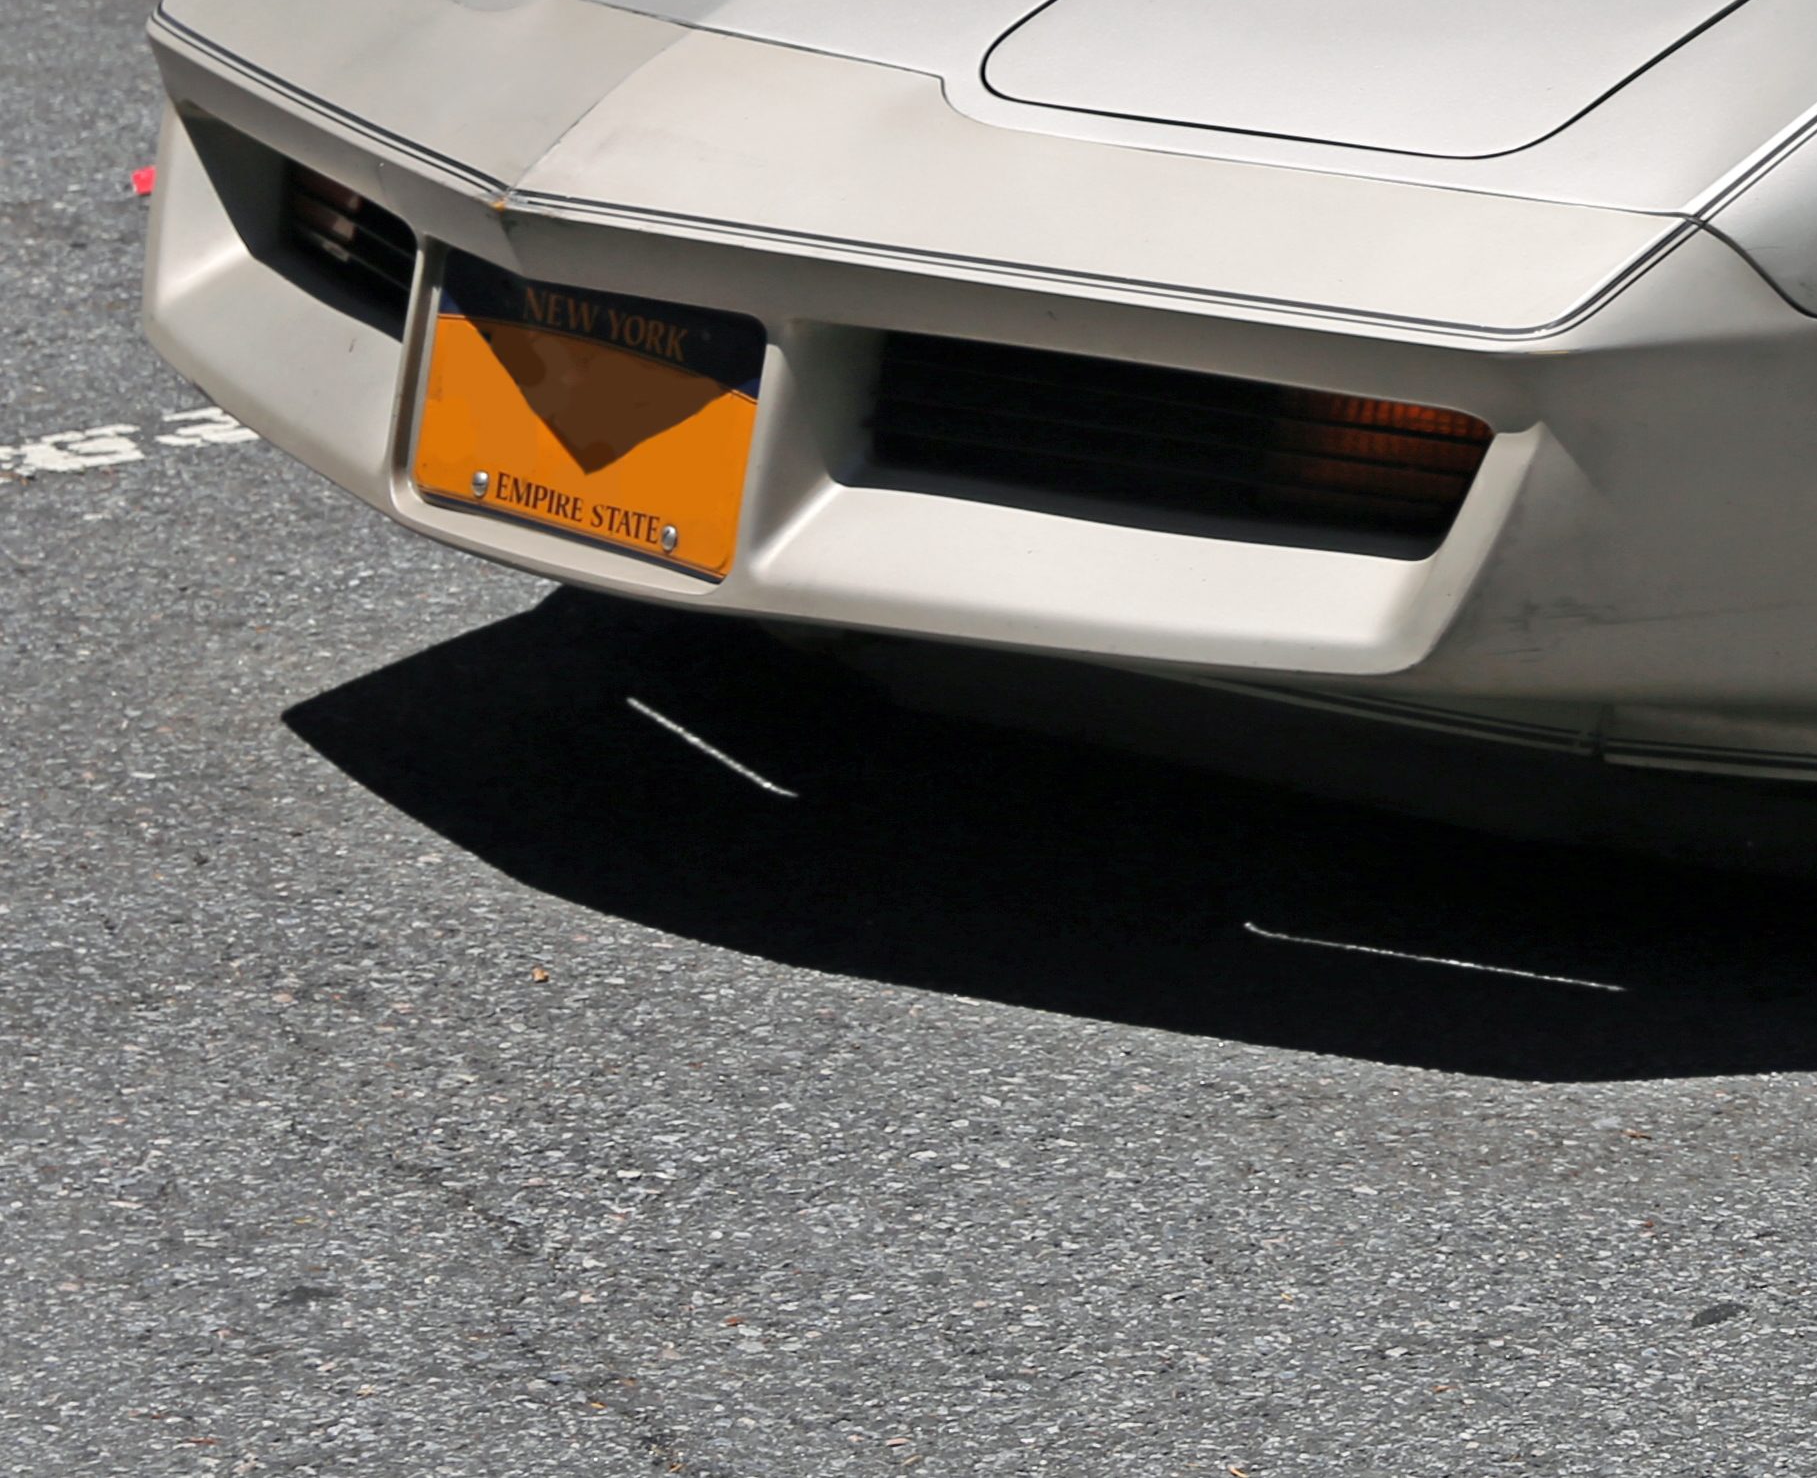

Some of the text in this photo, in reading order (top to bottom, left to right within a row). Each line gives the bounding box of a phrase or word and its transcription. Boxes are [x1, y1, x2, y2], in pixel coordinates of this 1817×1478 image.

[523, 286, 688, 362] NEW YORK
[494, 471, 661, 545] EMPIRE STATE
